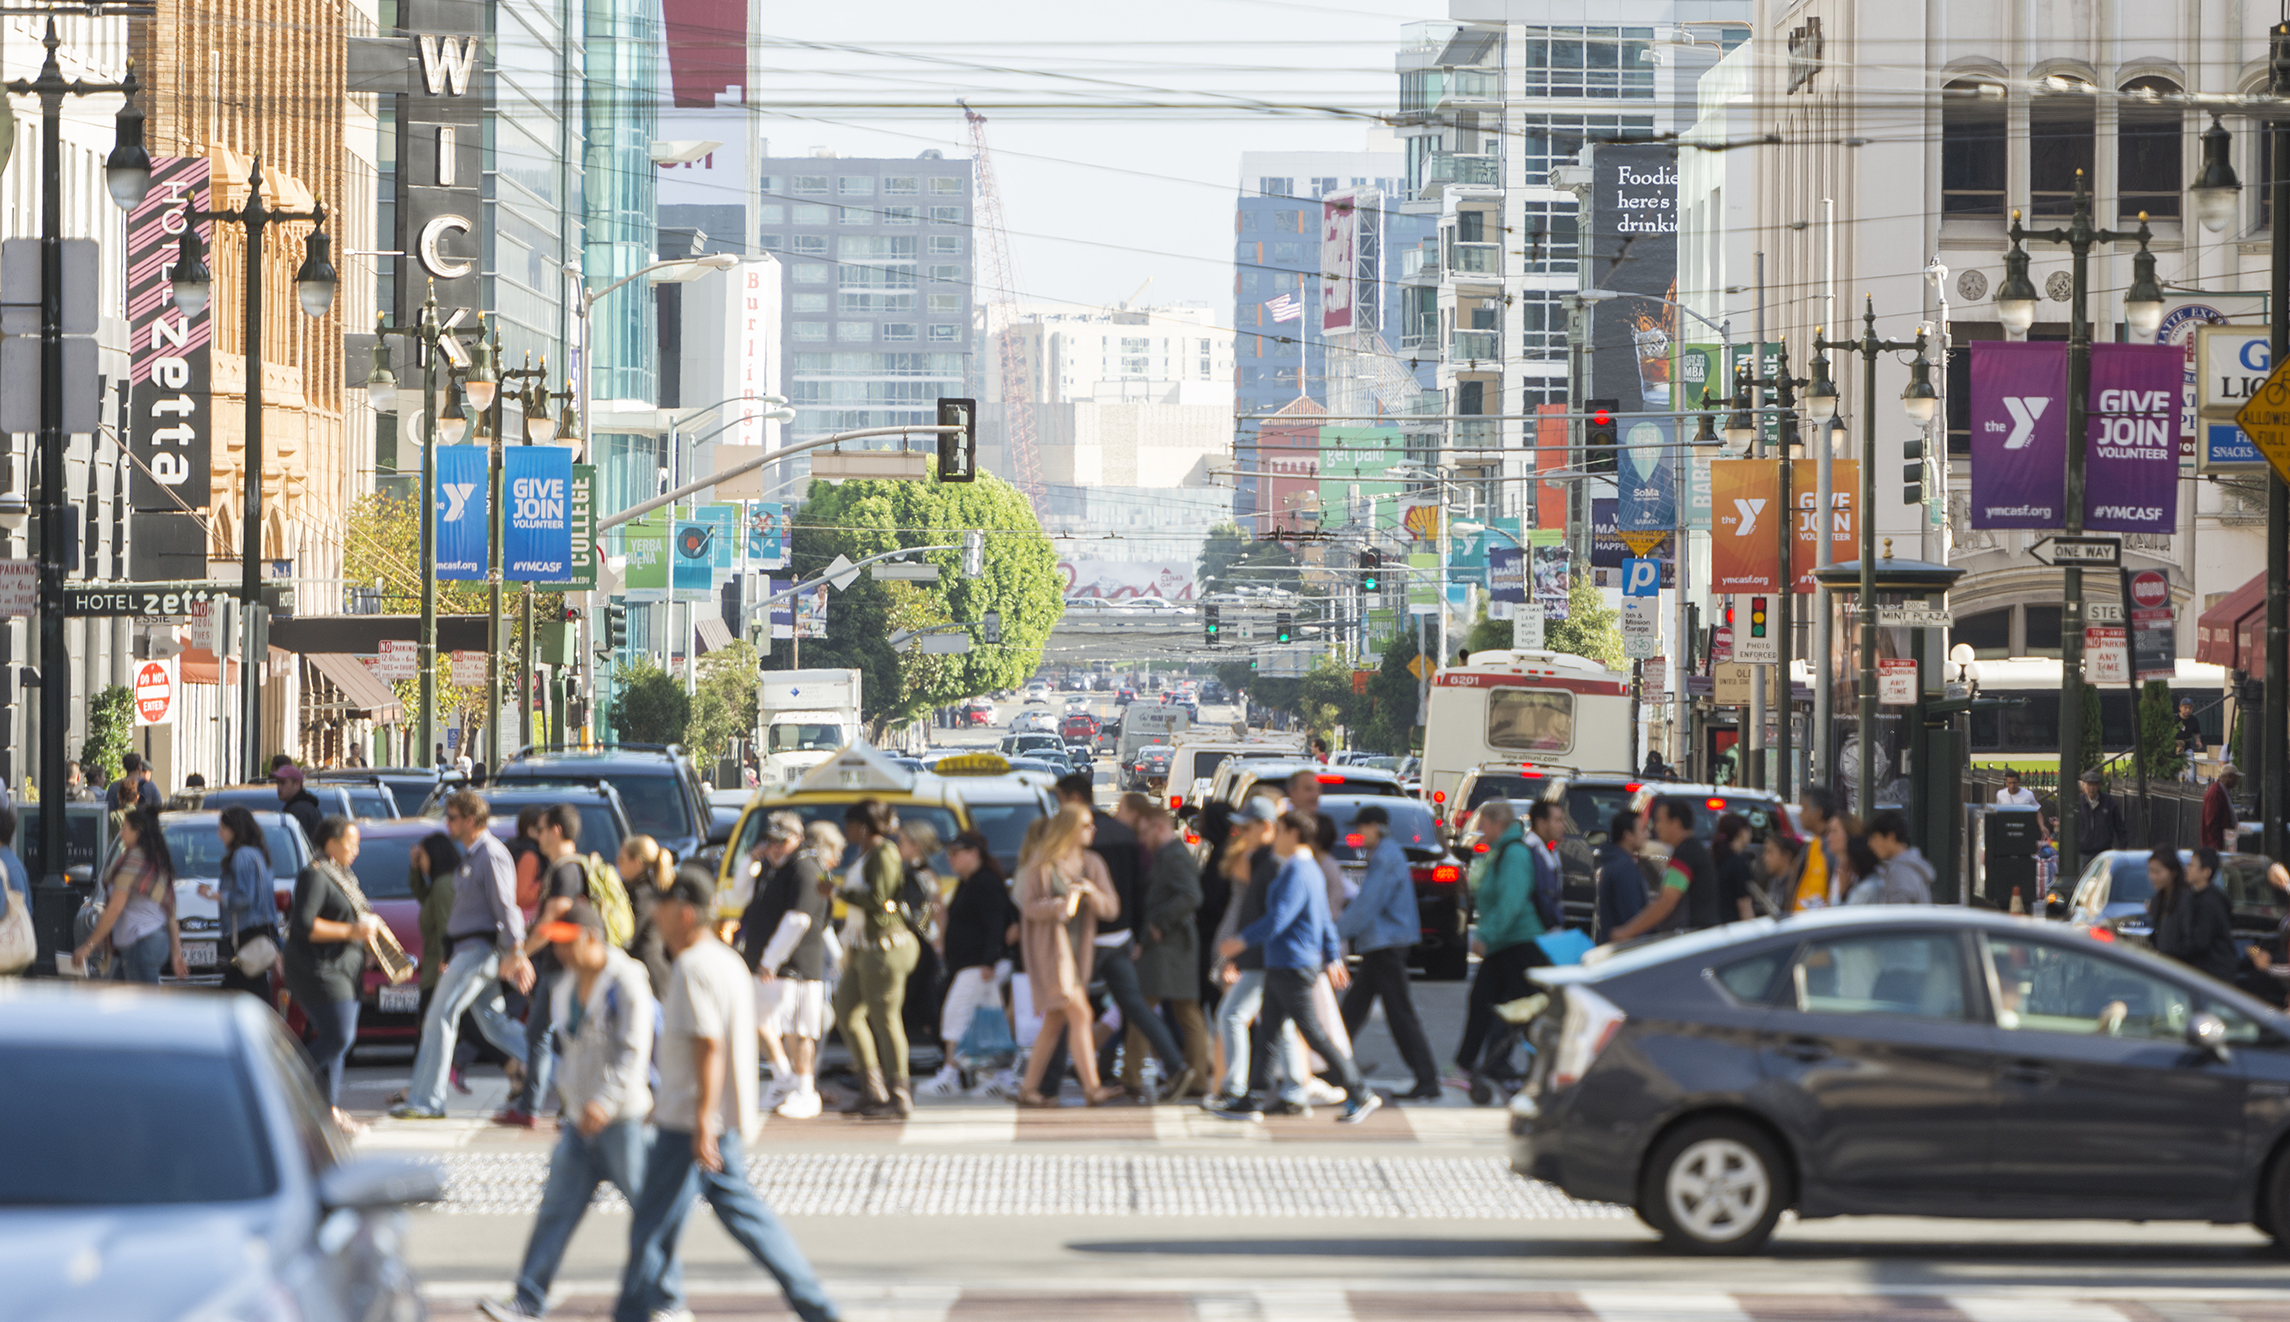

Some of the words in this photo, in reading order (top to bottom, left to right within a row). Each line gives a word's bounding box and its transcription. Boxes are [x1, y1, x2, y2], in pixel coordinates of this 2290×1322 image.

[1617, 189, 1670, 209] here's
[1685, 366, 1705, 377] MBA
[2100, 389, 2171, 418] GIVE
[1985, 420, 2007, 433] the
[2097, 418, 2169, 447] JOIN
[2258, 431, 2287, 446] FULL
[1326, 444, 1350, 468] get
[1354, 440, 1386, 467] paid
[2096, 446, 2168, 460] VOLUNTEER
[2212, 446, 2254, 458] SNACKS
[512, 478, 564, 499] GIVE
[1633, 488, 1660, 498] SoMa
[512, 498, 564, 520] JOIN
[1985, 504, 2052, 519] ymcasf.org
[2093, 506, 2163, 521] #YMCASF
[512, 519, 564, 530] VOLUNTEER
[572, 477, 590, 567] COLLEGE
[1721, 516, 1737, 525] the
[630, 538, 662, 552] YERBA
[1595, 542, 1631, 551] HAPPE
[2055, 545, 2081, 559] ONE
[2083, 545, 2113, 559] WAY
[435, 560, 478, 572] mcasf.org
[513, 560, 562, 573] #YMCASF
[1721, 575, 1769, 586] ymcasf.org
[76, 594, 138, 610] HOTEL
[143, 589, 229, 615] zett
[193, 603, 207, 616] NO
[1882, 612, 1908, 620] MINT
[1913, 612, 1951, 622] PLAZA
[194, 631, 210, 640] TUES
[2092, 629, 2126, 637] TOW-AWAY
[380, 641, 391, 652] NO
[392, 644, 417, 652] PARKING
[1746, 642, 1771, 650] PHOTO
[2086, 637, 2100, 647] NO
[2101, 640, 2127, 648] PARKIN
[453, 651, 463, 661] NO
[1739, 650, 1778, 659] ENFORCED
[2099, 653, 2119, 661] ANY
[1880, 667, 1892, 676] NO
[2097, 662, 2120, 671] TIME
[140, 673, 150, 685] DO
[152, 671, 166, 684] NOT
[1450, 675, 1480, 685] 6201
[143, 699, 164, 712] ENTER
